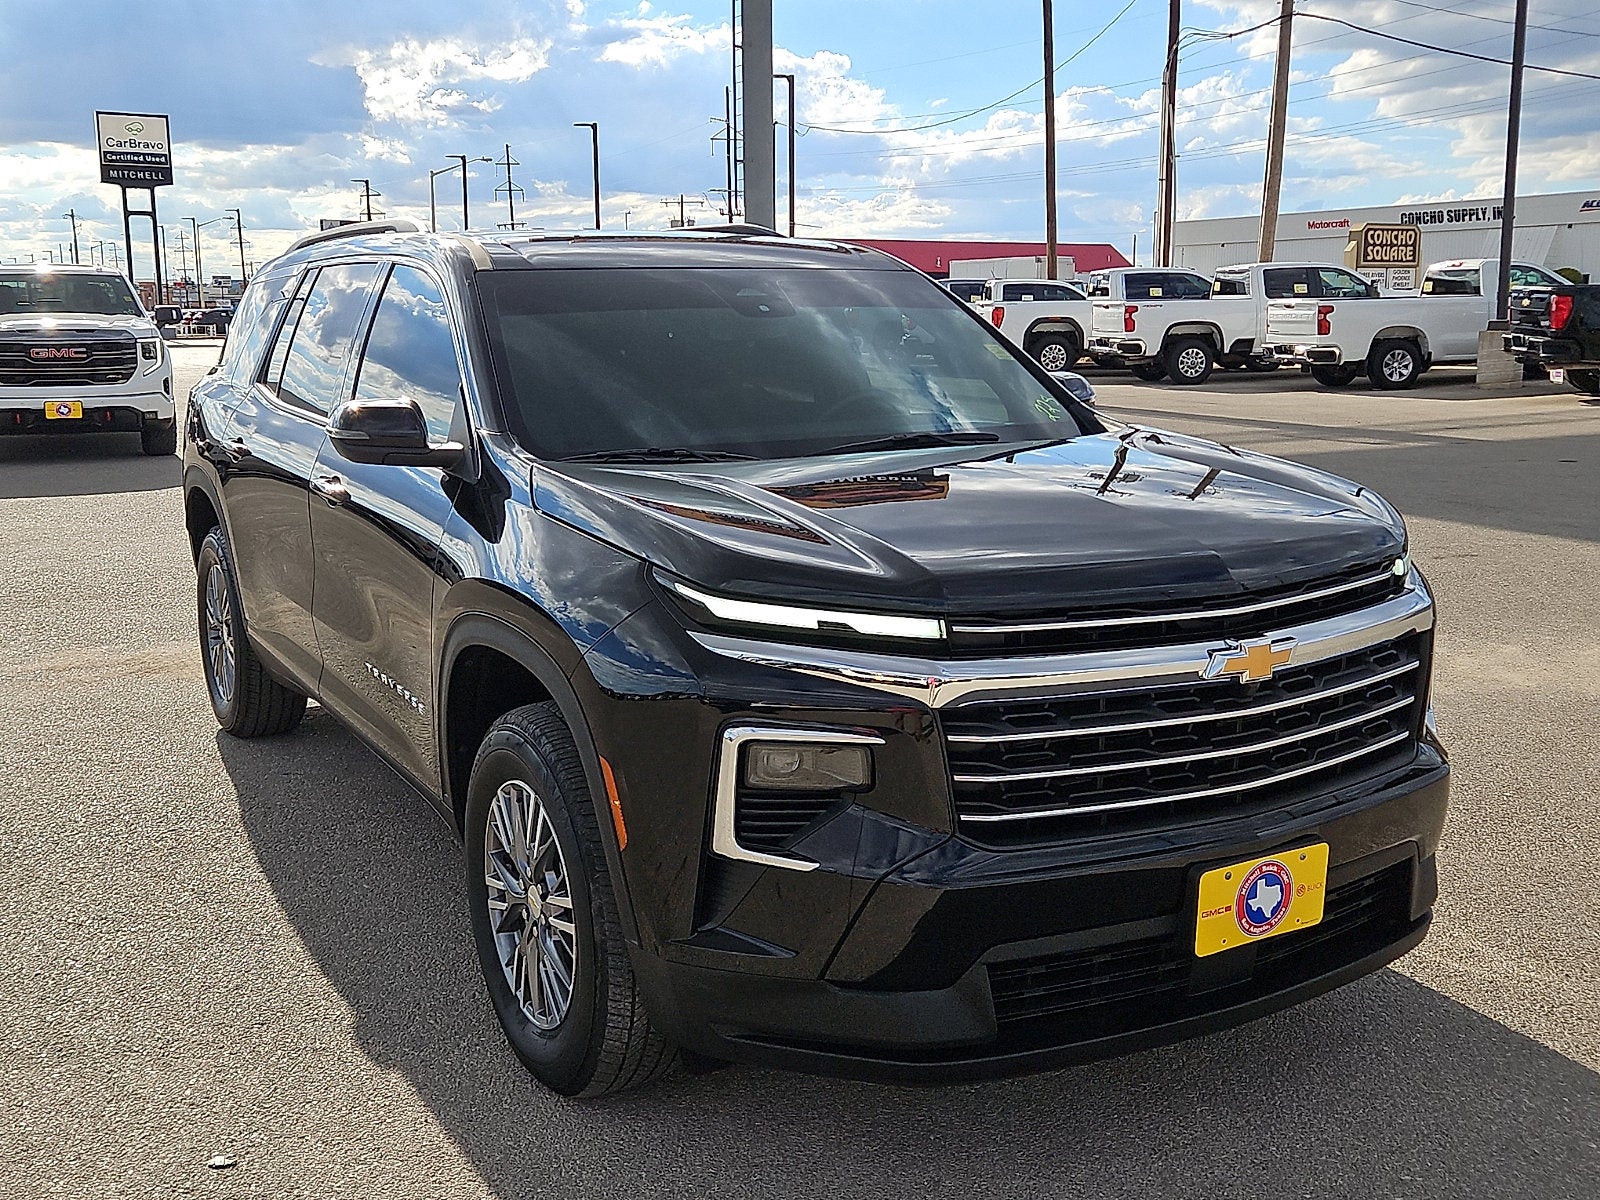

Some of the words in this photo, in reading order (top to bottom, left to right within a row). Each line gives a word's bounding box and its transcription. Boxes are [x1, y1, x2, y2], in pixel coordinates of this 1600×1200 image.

[105, 137, 164, 150] CarBravo
[106, 153, 144, 161] Certified
[109, 169, 165, 180] MITCHELL
[1400, 210, 1444, 225] CONCHO
[1446, 207, 1491, 223] SUPPLY,
[1307, 218, 1350, 229] Motorcraft
[1367, 230, 1415, 245] CONCHO
[1366, 246, 1414, 261] SQUARE
[30, 348, 87, 359] GMC
[364, 661, 427, 715] TRAVERSE
[1240, 868, 1260, 896] Mitchell
[1201, 906, 1226, 919] GMC
